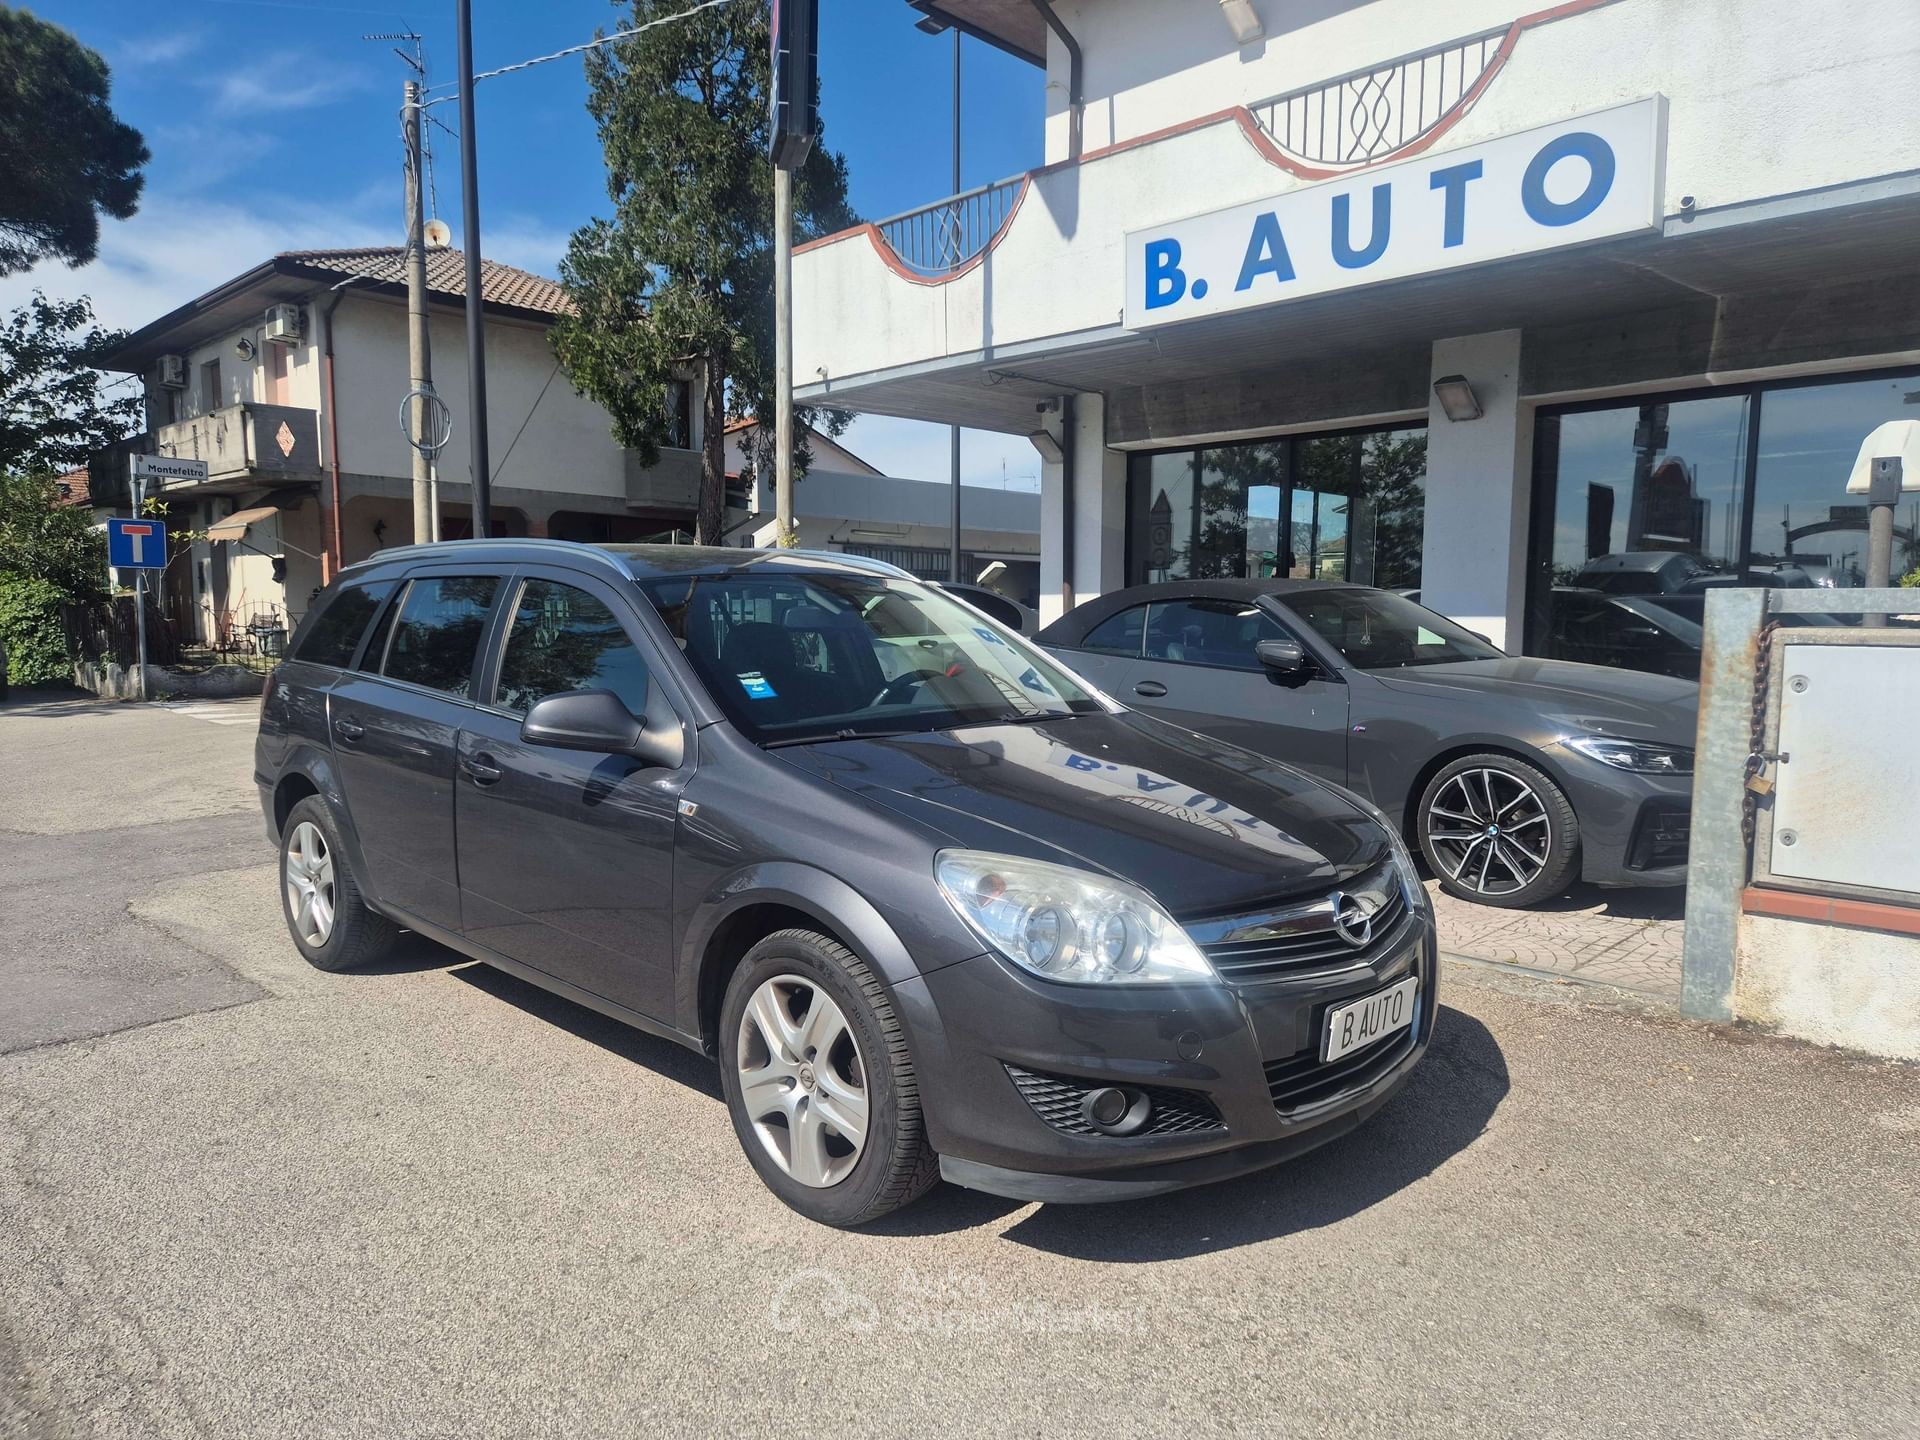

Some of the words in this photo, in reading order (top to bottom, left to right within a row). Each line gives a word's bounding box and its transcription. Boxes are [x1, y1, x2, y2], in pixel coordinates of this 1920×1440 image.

[1145, 238, 1209, 310] B.
[1234, 131, 1616, 292] AUTO
[148, 464, 204, 477] Montefeltro
[1341, 1011, 1355, 1050] B.
[1357, 990, 1404, 1041] AUTO
